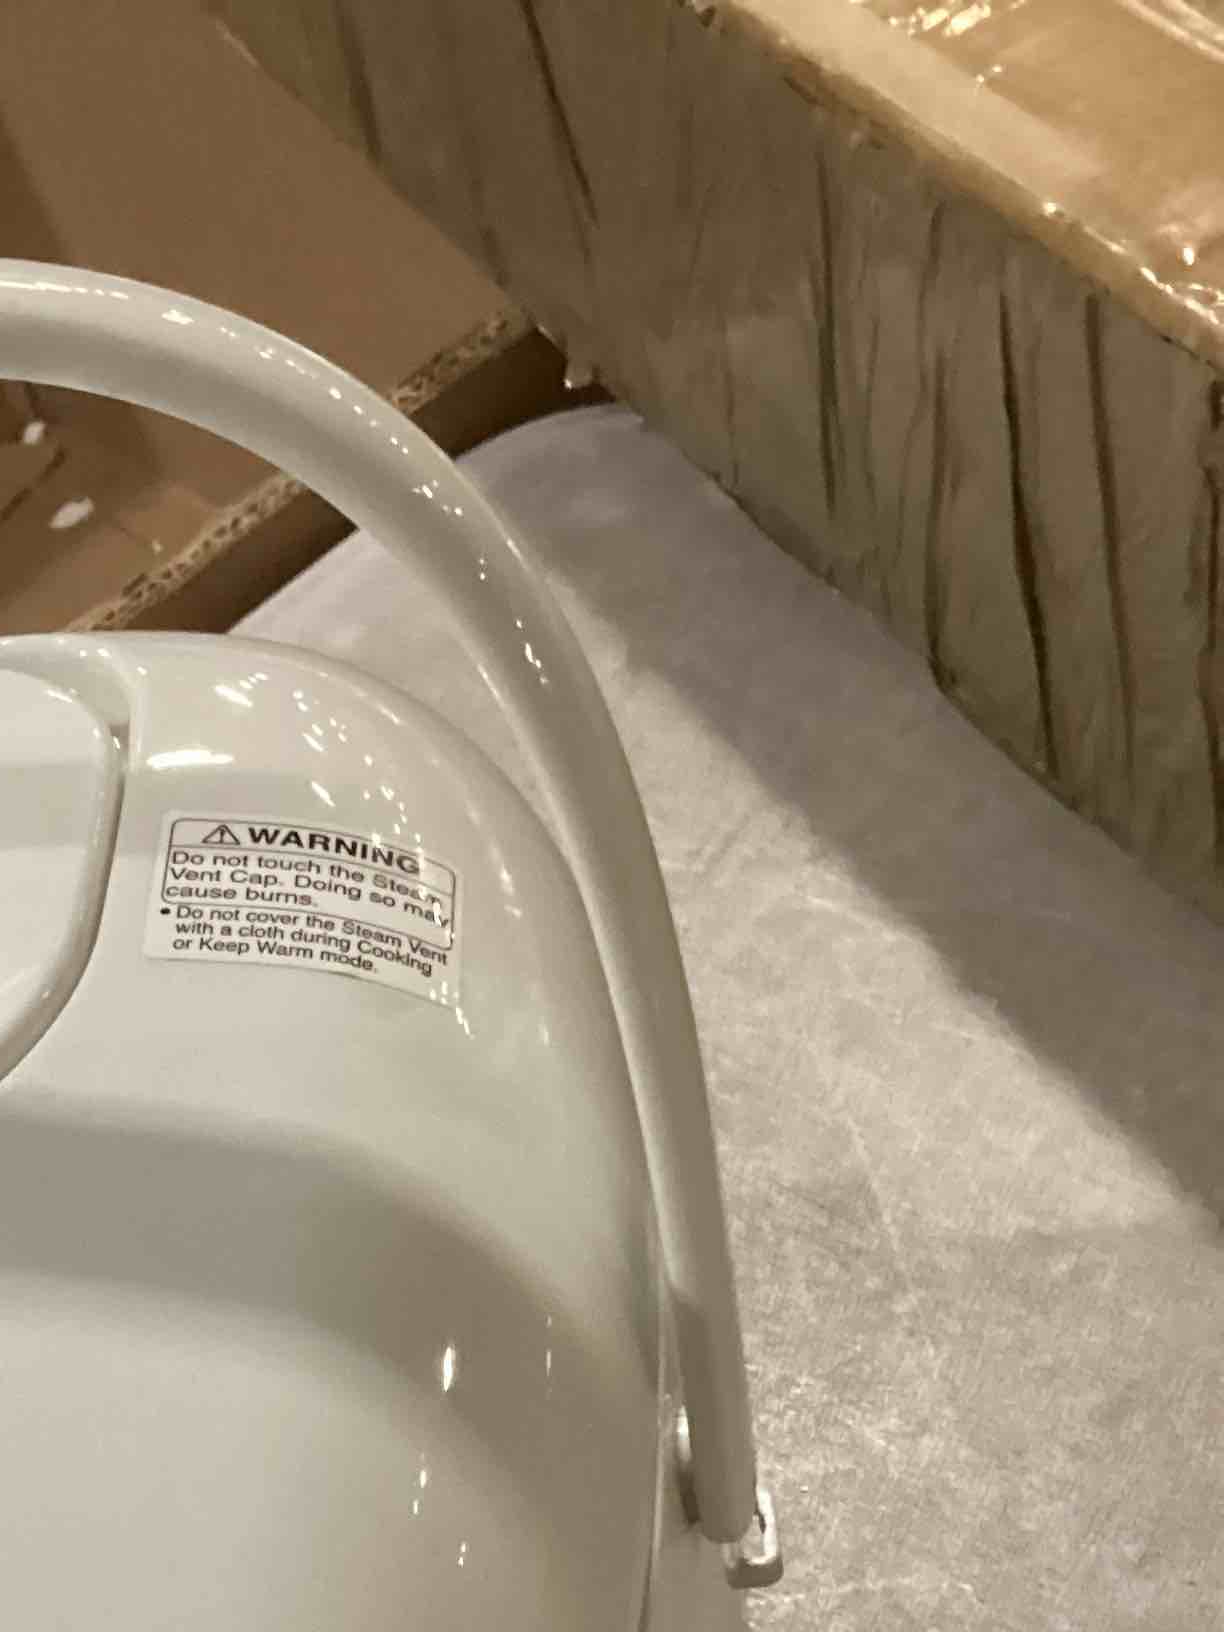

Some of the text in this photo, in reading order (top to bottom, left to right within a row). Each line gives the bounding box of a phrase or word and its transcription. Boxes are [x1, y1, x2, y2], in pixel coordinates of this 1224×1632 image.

[172, 851, 204, 866] Do
[212, 855, 249, 868] not
[258, 857, 321, 873] touch
[330, 864, 365, 883] the
[248, 826, 421, 875] WARNING
[165, 886, 318, 907] cause burns.
[170, 868, 222, 883] Vent
[230, 869, 284, 888] Cap.
[294, 874, 362, 901] Doing
[369, 892, 396, 908] so
[172, 937, 379, 974] or Keep Warm mode.
[176, 905, 448, 966] Do not cover the Steam Vent
[176, 922, 433, 977] with a cloth during Cooking
